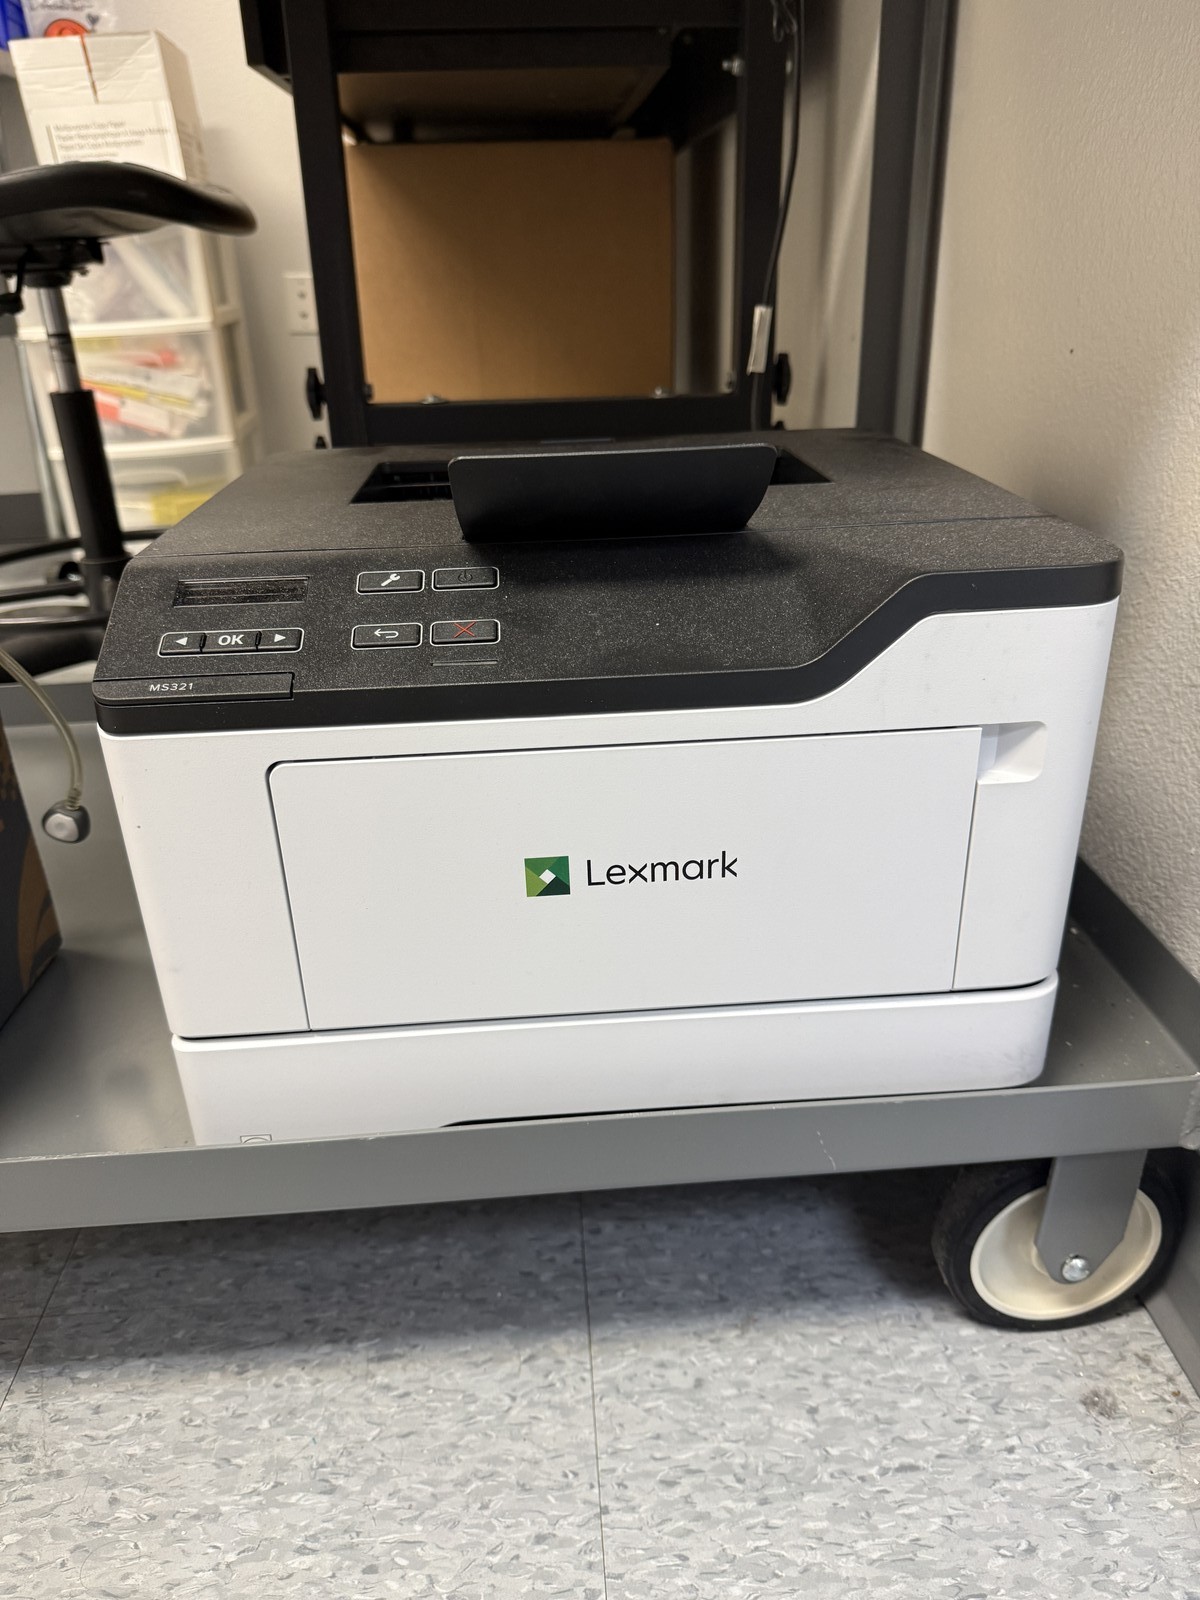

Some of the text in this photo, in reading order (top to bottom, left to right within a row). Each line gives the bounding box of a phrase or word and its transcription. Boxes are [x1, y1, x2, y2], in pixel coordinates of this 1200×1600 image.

[217, 634, 245, 646] OK
[149, 682, 194, 692] MS321
[586, 850, 738, 887] Lexmark
